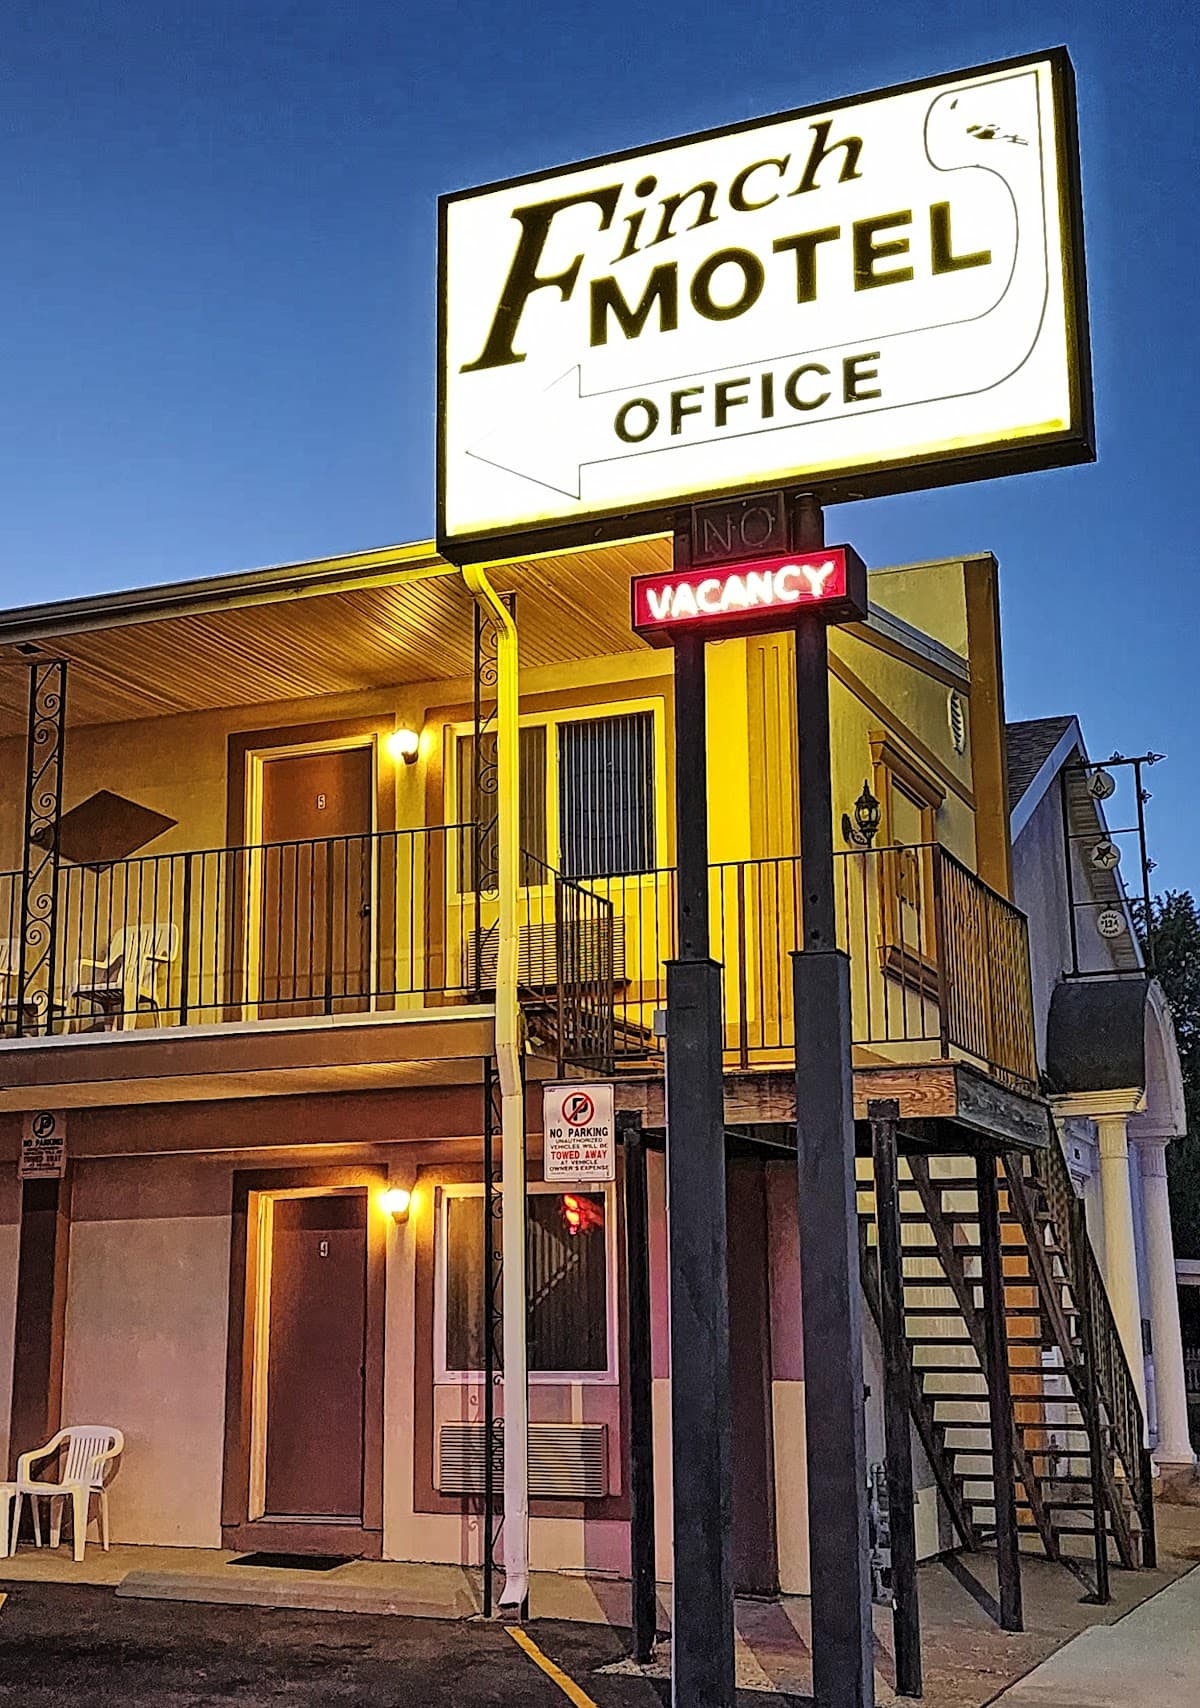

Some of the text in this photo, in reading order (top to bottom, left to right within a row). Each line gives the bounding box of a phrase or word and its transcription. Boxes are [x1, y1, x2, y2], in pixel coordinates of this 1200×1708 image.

[459, 119, 863, 374] Finch
[589, 200, 992, 348] MOTEL
[613, 350, 882, 444] OFFICE
[703, 506, 773, 553] NO
[645, 560, 836, 620] VACANCY
[550, 1127, 608, 1138] NO PARKING
[551, 1149, 608, 1160] TOWED AWAY
